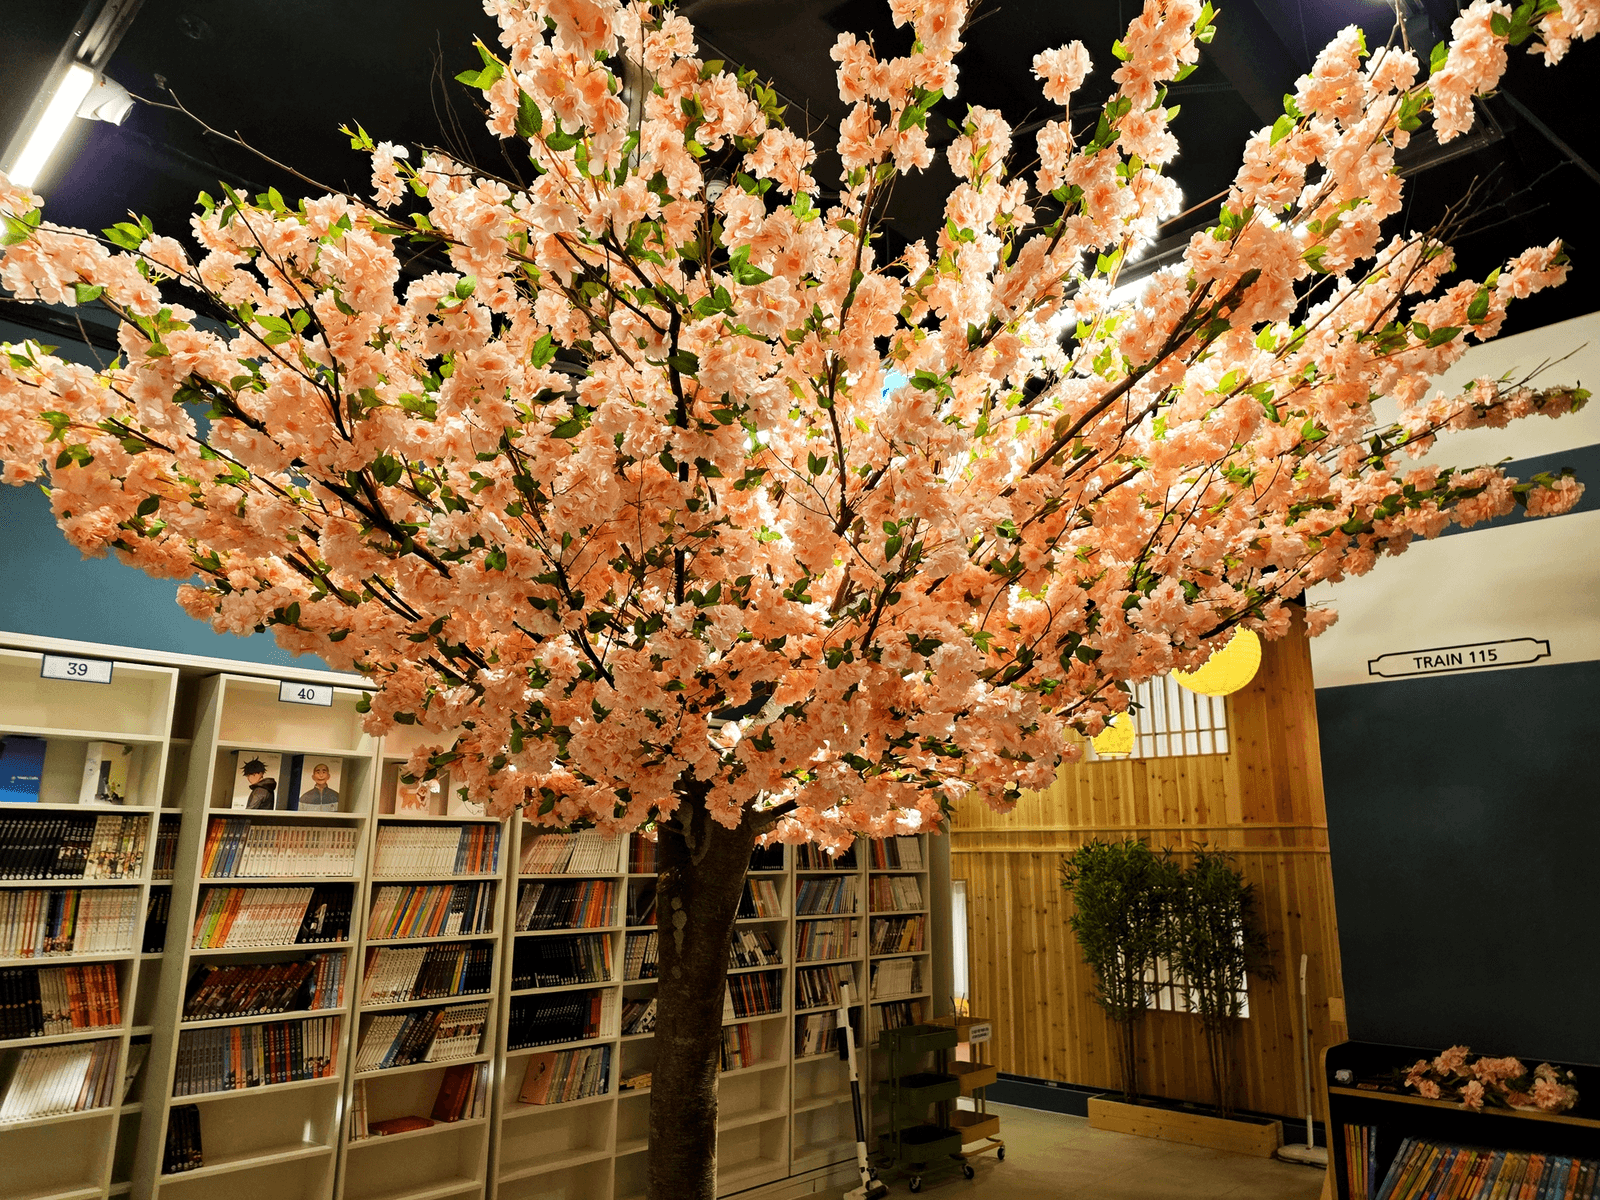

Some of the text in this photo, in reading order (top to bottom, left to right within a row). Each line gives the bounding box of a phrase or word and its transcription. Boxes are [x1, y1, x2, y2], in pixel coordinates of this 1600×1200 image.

[1413, 648, 1498, 669] TRAIN 115
[66, 662, 88, 676] 39
[297, 688, 315, 700] 40
